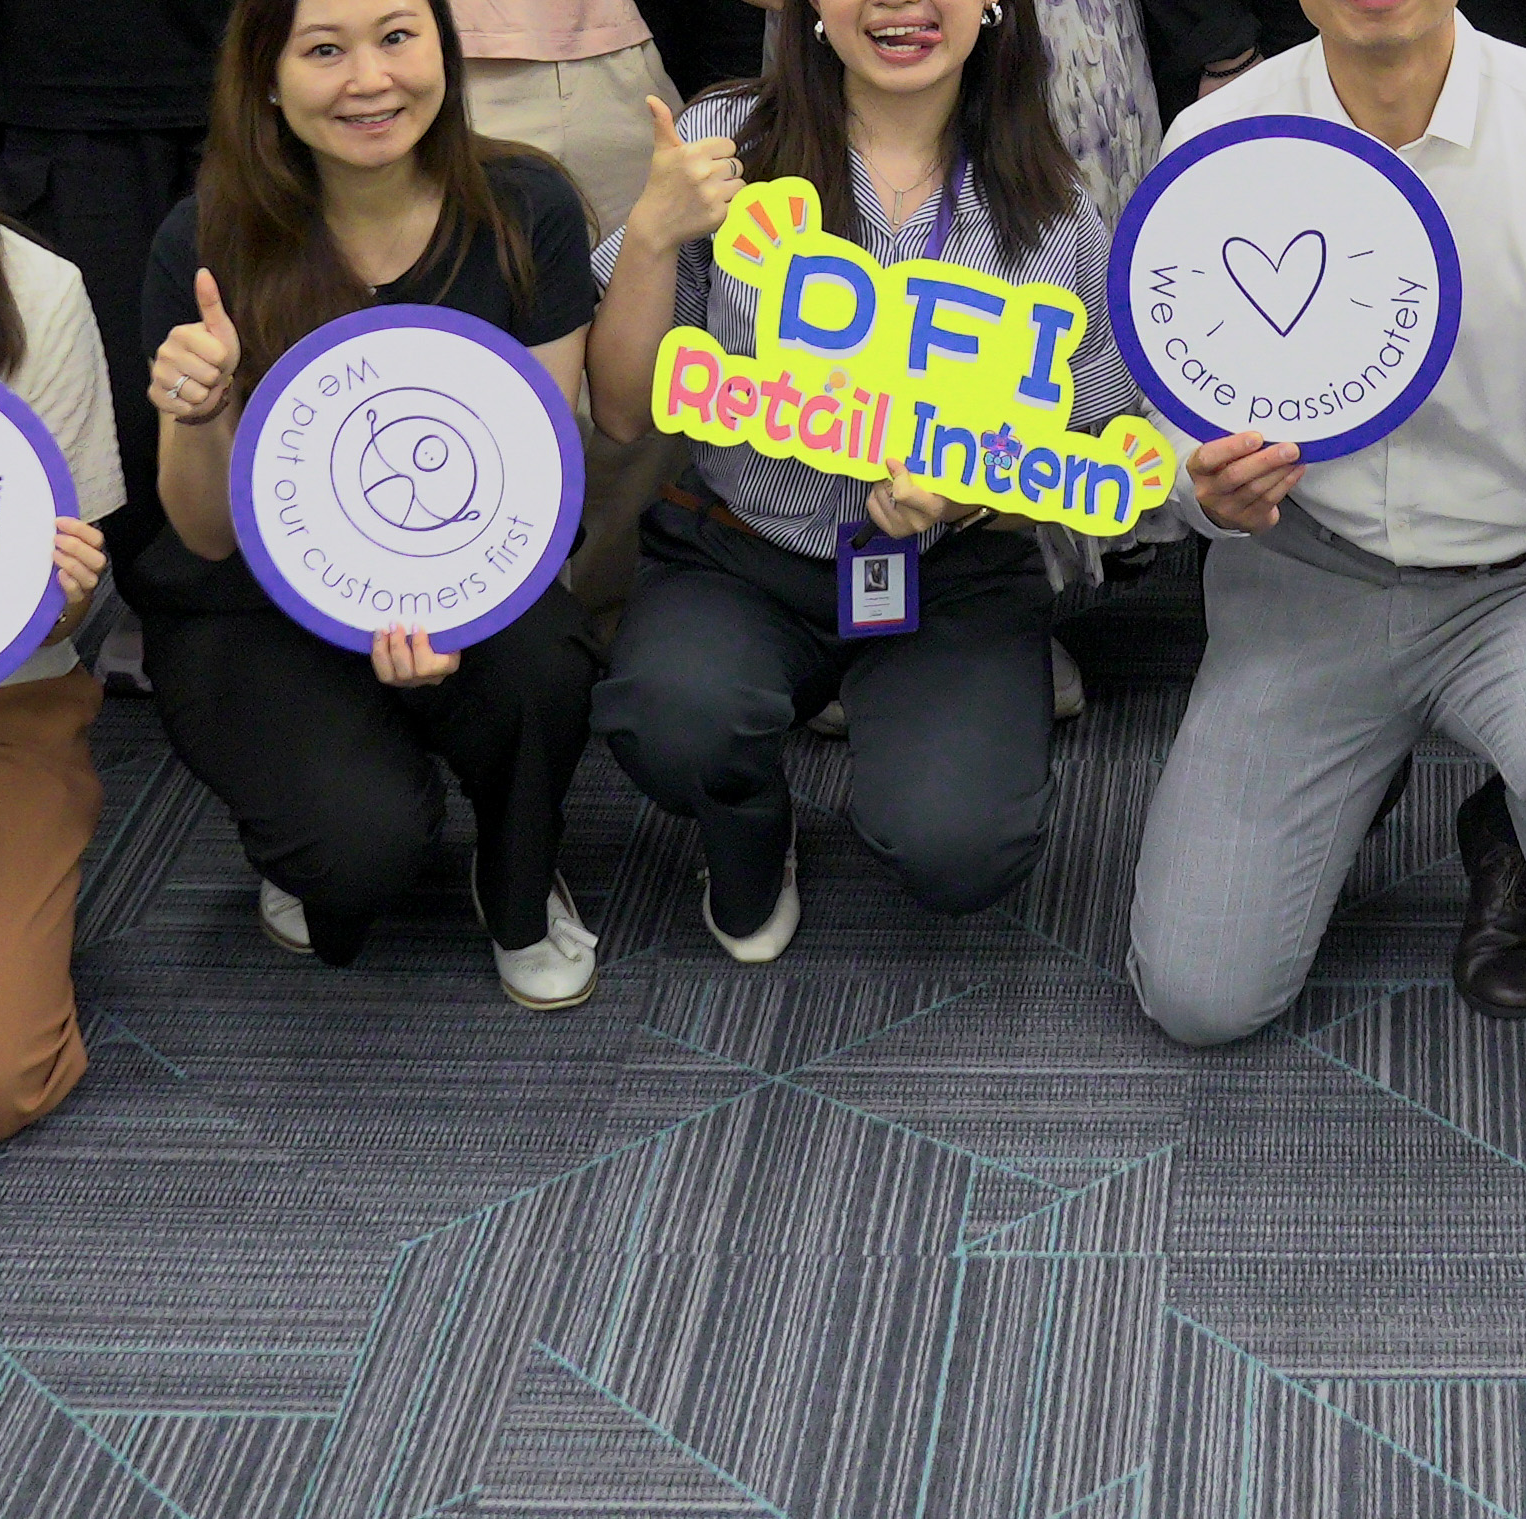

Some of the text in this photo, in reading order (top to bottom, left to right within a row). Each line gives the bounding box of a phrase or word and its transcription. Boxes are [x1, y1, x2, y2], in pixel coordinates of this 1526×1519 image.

[778, 254, 1074, 403] DFI
[1149, 265, 1428, 424] We care passionately
[274, 357, 535, 615] We put our customers first
[667, 344, 1136, 523] Retail Intern
